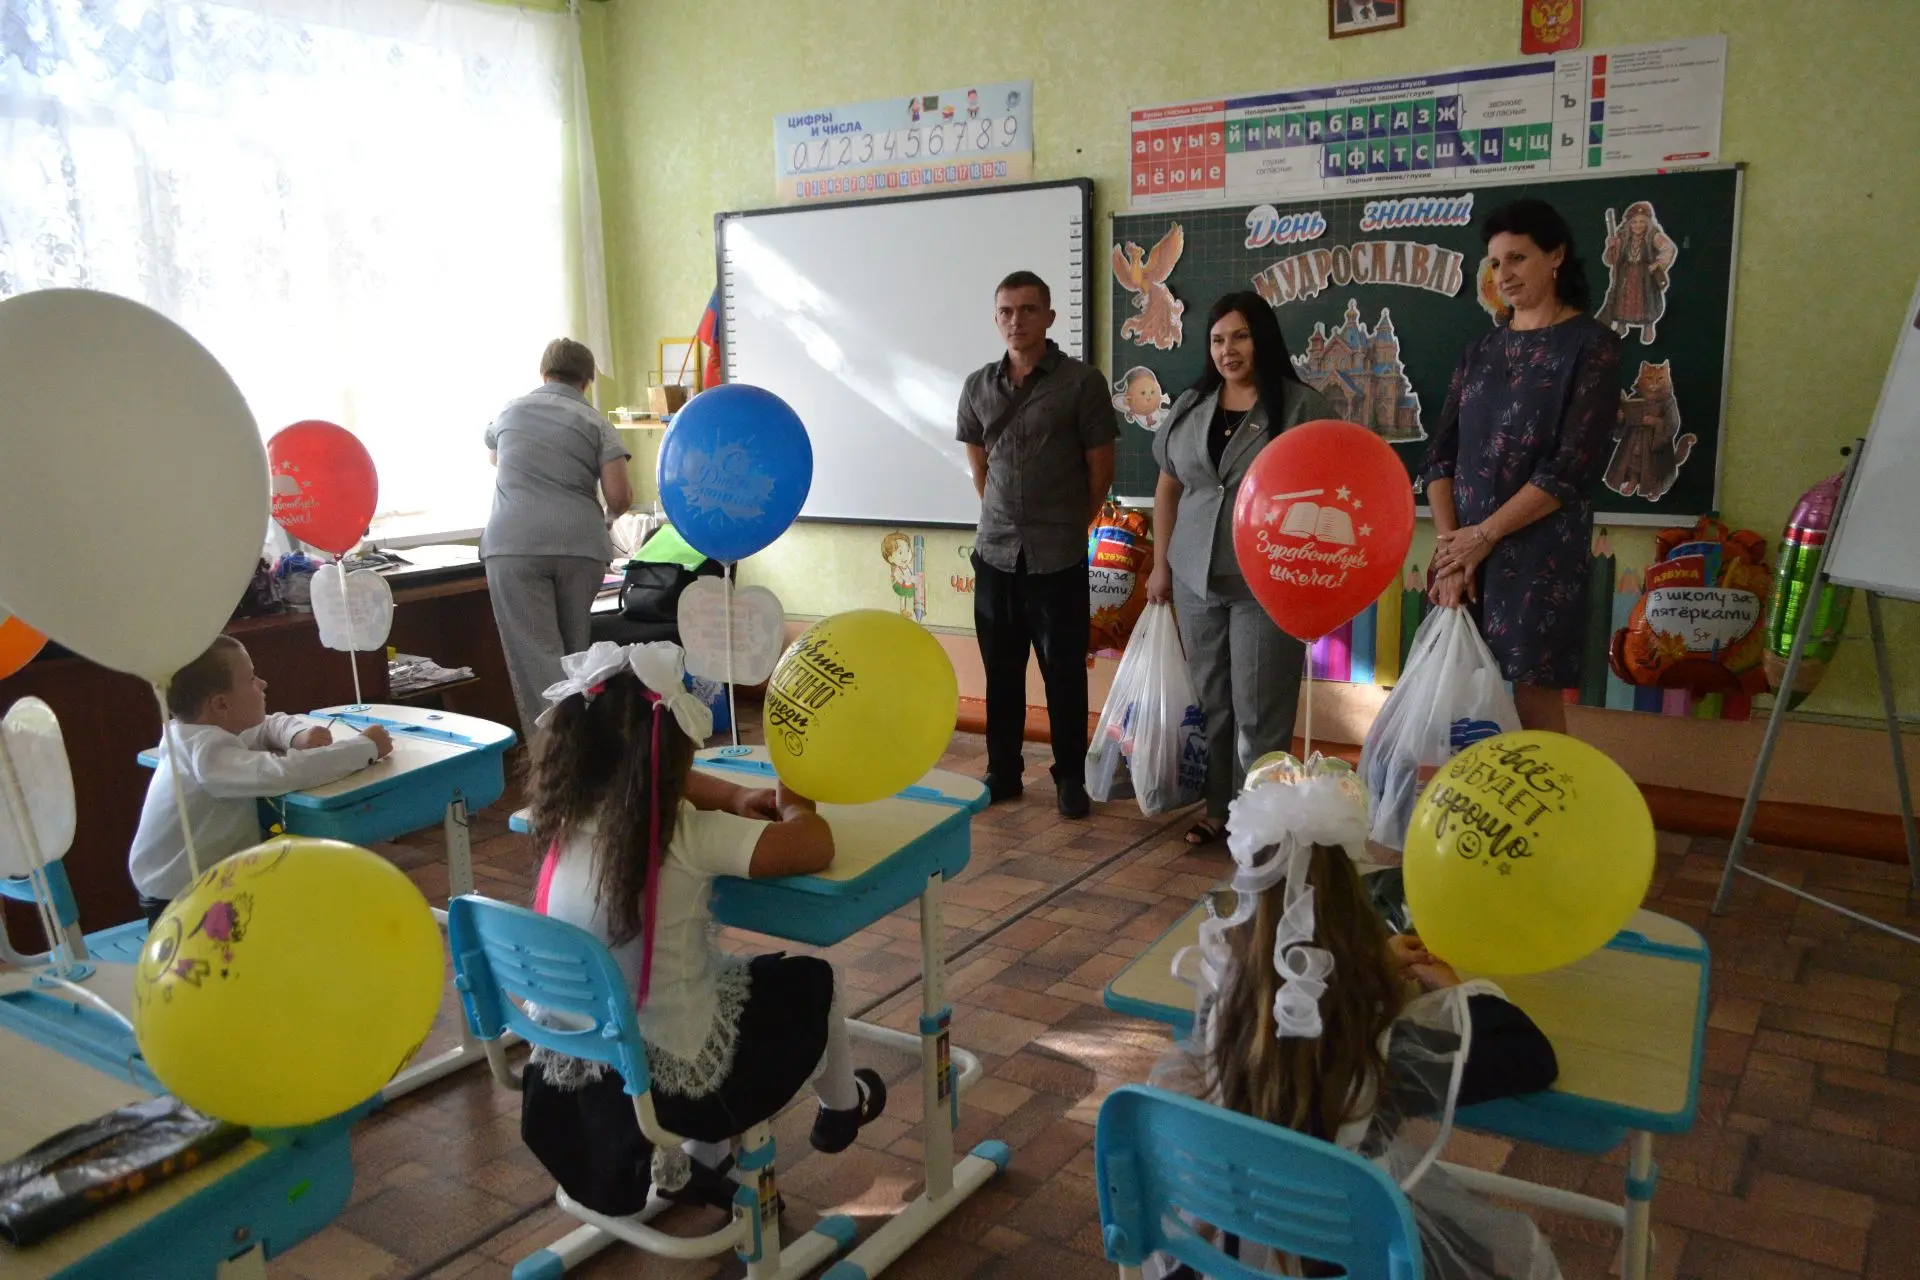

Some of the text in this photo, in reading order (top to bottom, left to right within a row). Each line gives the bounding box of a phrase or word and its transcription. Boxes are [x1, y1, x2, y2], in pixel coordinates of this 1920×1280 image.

[788, 112, 833, 128] ЦИФРЫ
[811, 121, 862, 136] И ЧИСЛА
[1246, 206, 1325, 247] День
[1253, 242, 1463, 305] МУДРОСЛАВЛЬ
[1653, 569, 1699, 584] АЗБУКА
[1667, 591, 1726, 607] школу
[1651, 606, 1751, 625] пятёрками
[1464, 761, 1553, 827] БУДЕТ
